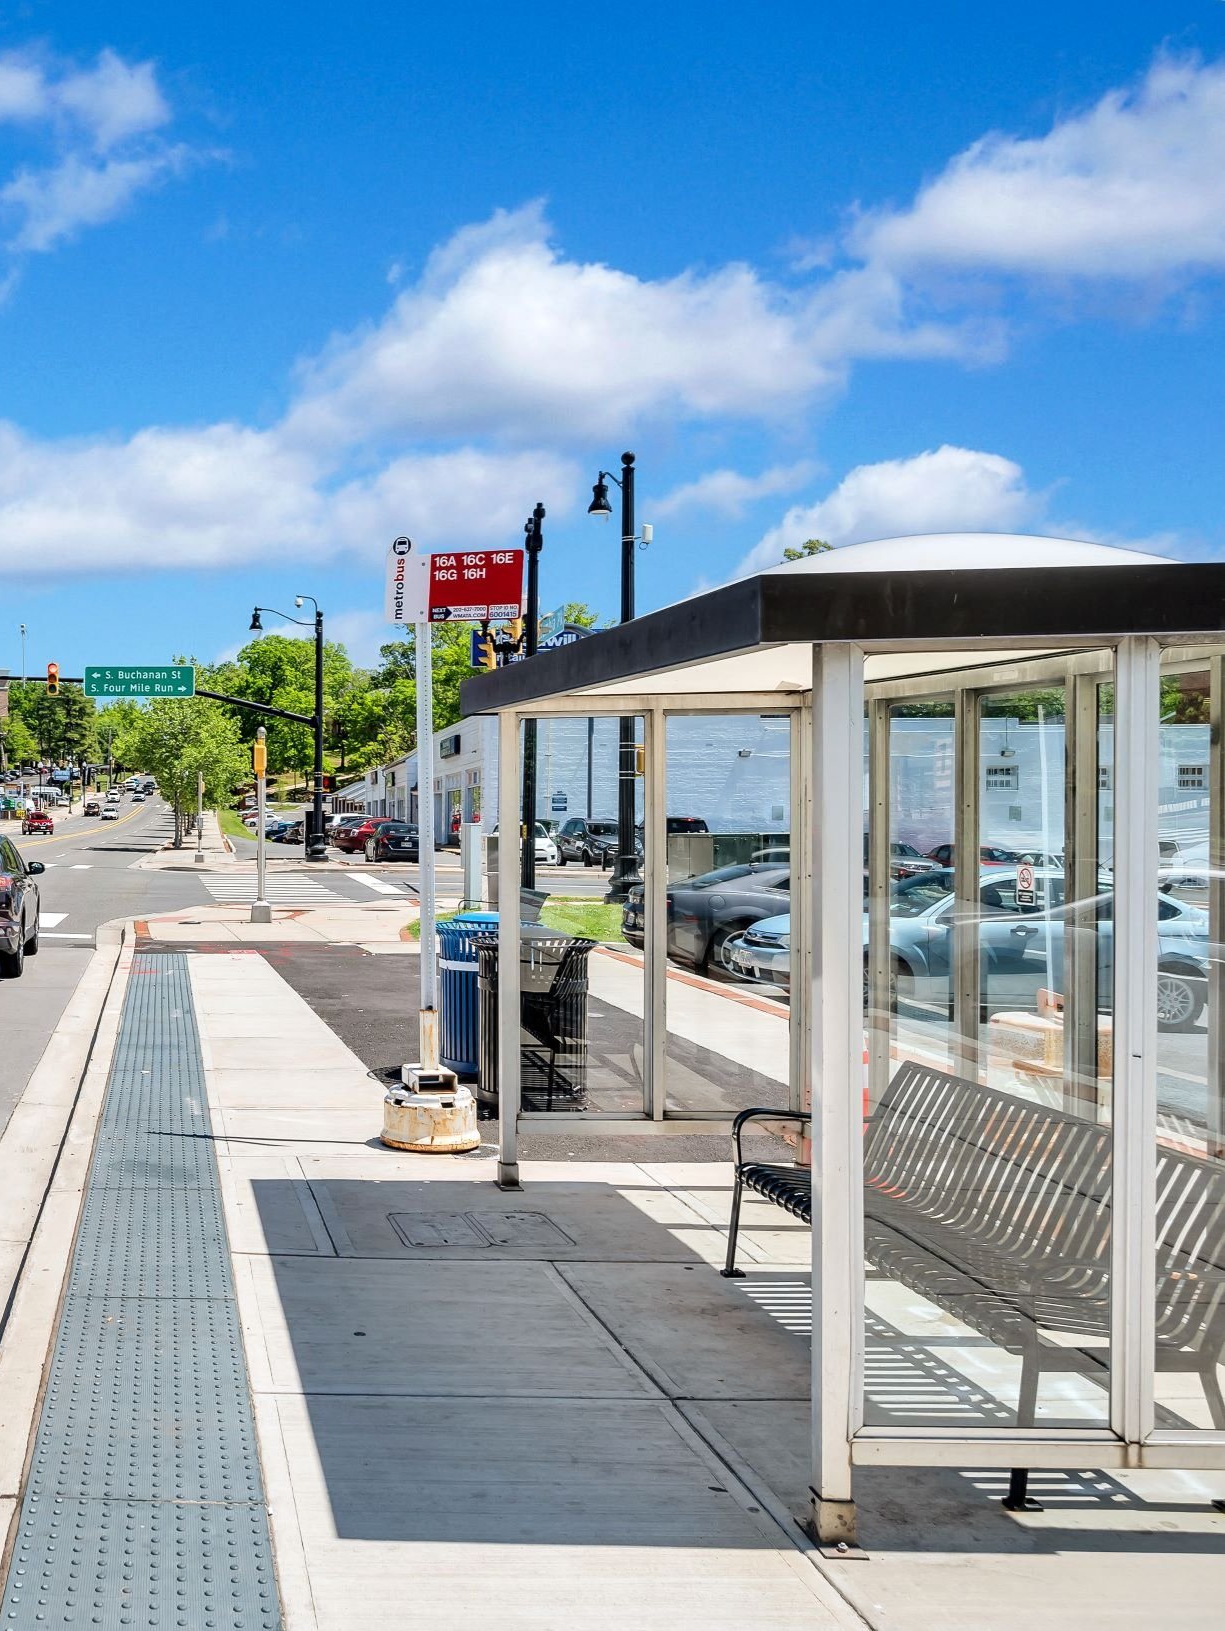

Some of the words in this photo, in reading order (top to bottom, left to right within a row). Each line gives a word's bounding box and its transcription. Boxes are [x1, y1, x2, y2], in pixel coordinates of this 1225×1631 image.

[434, 555, 456, 567] 16A
[462, 554, 486, 566] 16C
[490, 552, 514, 564] 16E
[433, 569, 458, 581] 16G
[462, 568, 486, 580] 16H
[393, 558, 405, 620] metrobus
[105, 670, 114, 679] S.
[118, 670, 167, 679] Buchanan
[171, 670, 181, 679] St
[91, 683, 99, 692] S.
[103, 683, 126, 692] Four
[130, 683, 151, 692] Mile
[155, 683, 173, 692] Run
